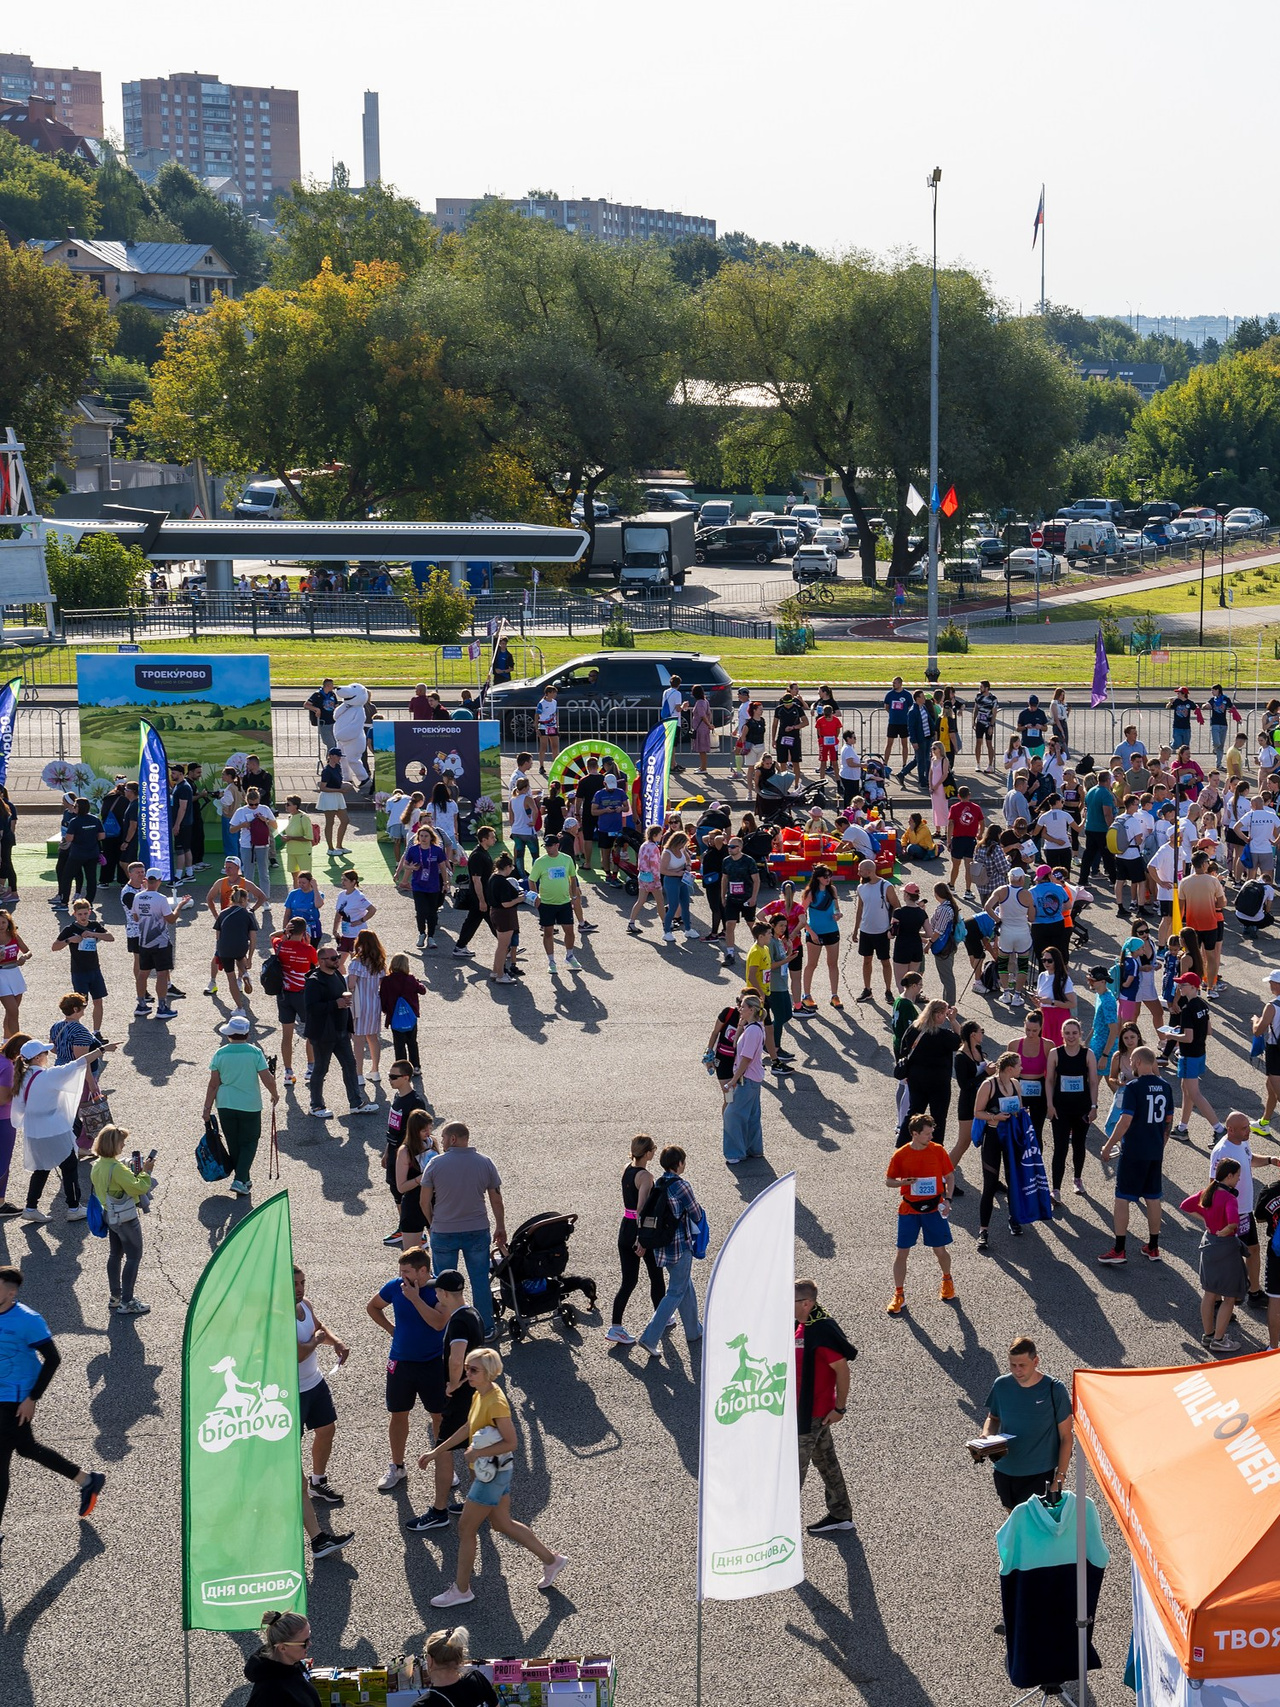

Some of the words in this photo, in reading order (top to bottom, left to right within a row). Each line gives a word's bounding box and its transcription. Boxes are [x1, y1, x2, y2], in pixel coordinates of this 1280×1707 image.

[1, 716, 13, 769] УРОВО
[645, 755, 656, 828] ОЕКУРОВО
[149, 763, 163, 860] ТРОЕКУРОВО
[1147, 1095, 1167, 1124] 13
[918, 1186, 934, 1194] 3239
[202, 1414, 290, 1443] bionova
[716, 1556, 742, 1568] ДНЯ
[206, 1585, 226, 1598] ДНЯ
[239, 1578, 295, 1595] ОСНОВА
